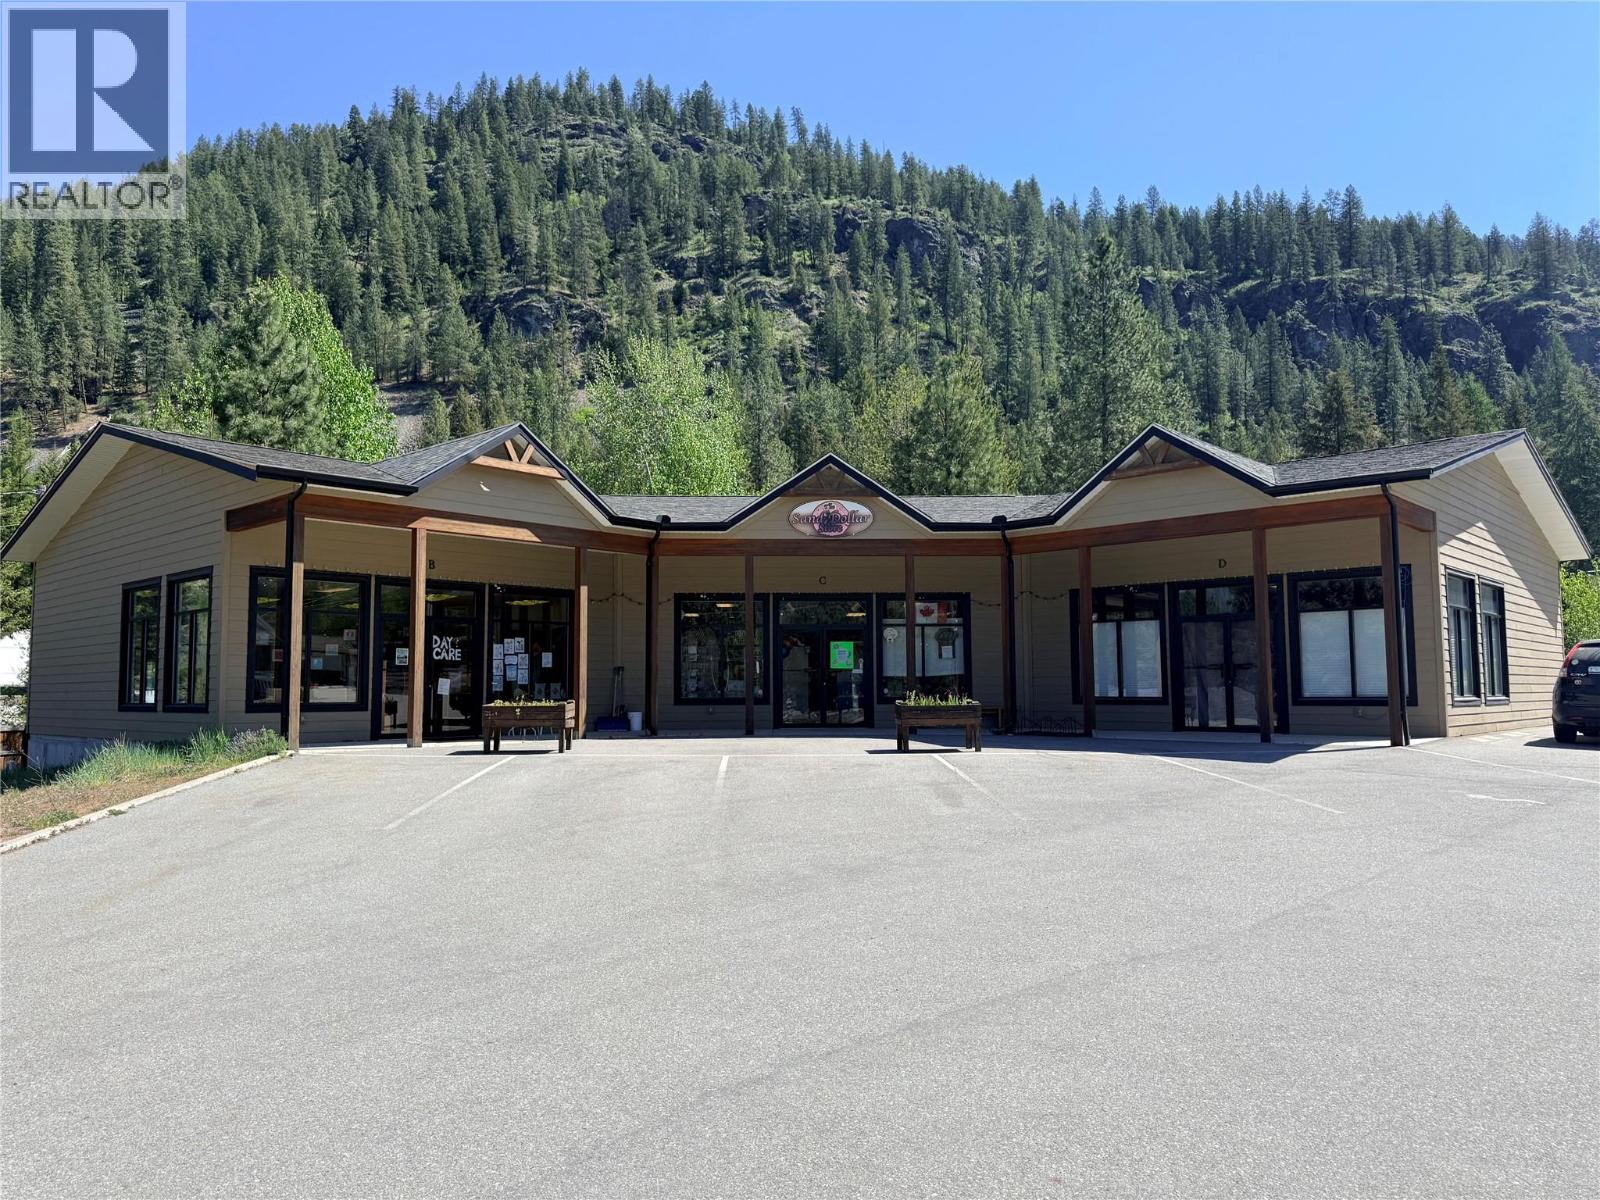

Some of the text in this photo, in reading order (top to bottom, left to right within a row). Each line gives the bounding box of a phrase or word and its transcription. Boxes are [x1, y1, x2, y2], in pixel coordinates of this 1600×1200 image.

[792, 509, 871, 525] Sand Dollar
[428, 559, 436, 569] B
[1218, 558, 1228, 569] D
[818, 576, 827, 585] C
[432, 635, 453, 649] DAY
[432, 648, 462, 661] CARE
